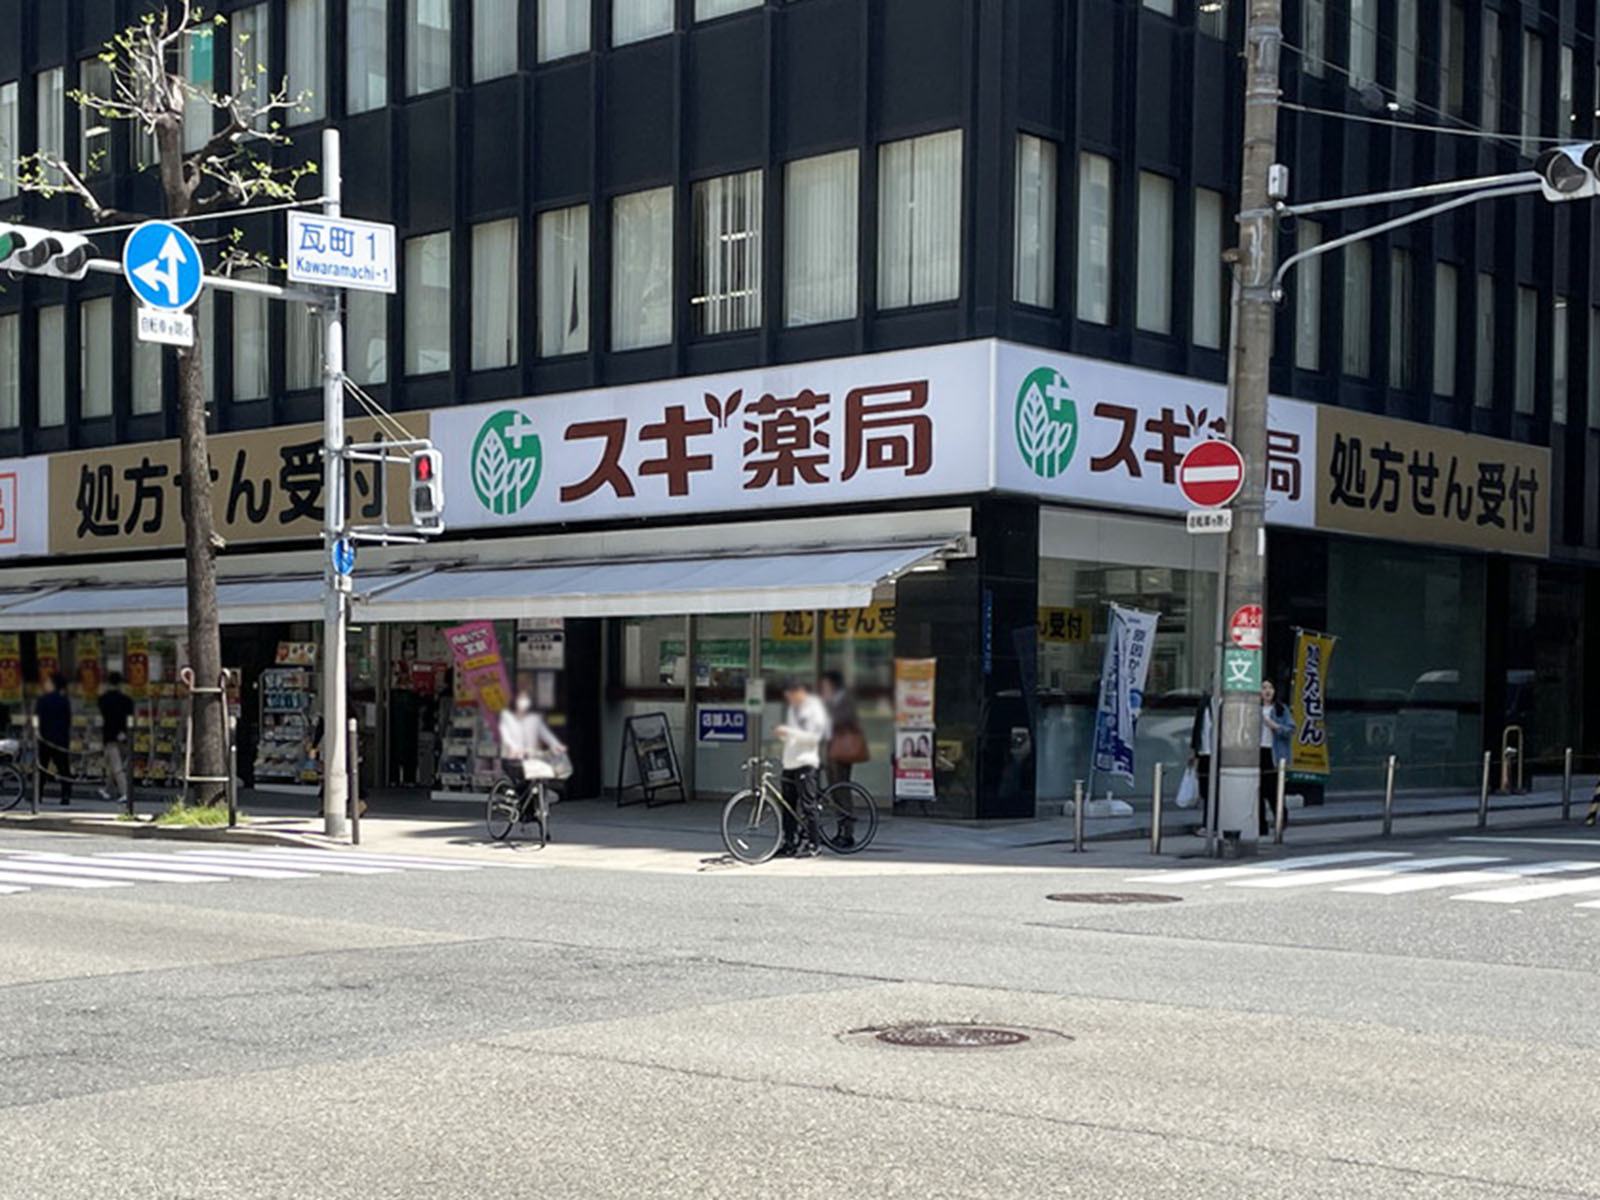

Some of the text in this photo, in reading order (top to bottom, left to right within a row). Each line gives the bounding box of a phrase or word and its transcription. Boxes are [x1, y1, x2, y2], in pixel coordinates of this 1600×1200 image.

[296, 256, 389, 282] Kawaramachi-1
[75, 430, 389, 539] 処方ん受付
[560, 378, 933, 503] スギ薬局
[1090, 402, 1301, 502] スギ局
[1329, 432, 1539, 534] 処方せん受付
[1227, 658, 1253, 682] 文
